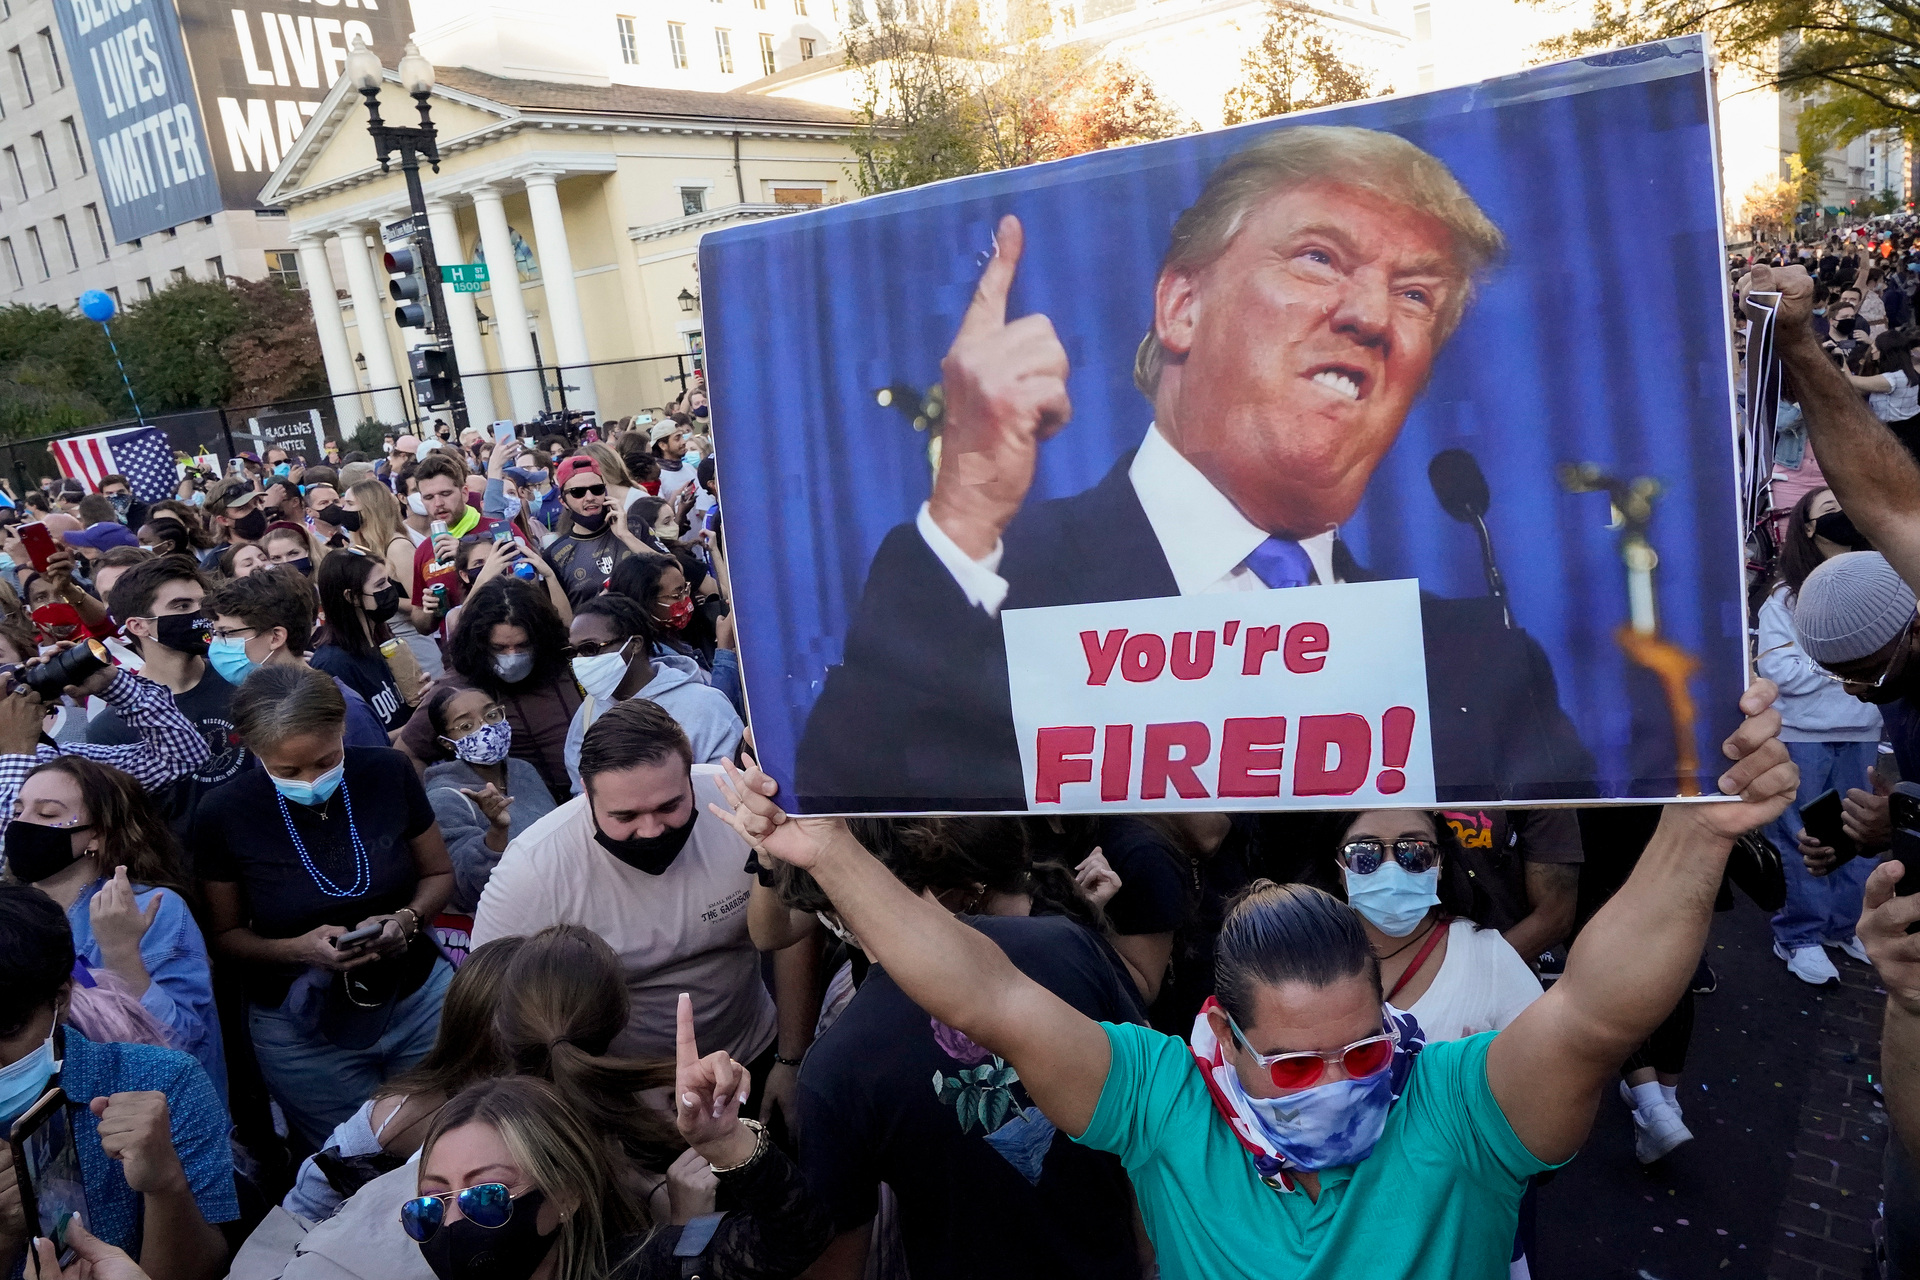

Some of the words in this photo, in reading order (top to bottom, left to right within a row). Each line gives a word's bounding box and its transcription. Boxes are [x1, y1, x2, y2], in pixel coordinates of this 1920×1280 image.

[89, 18, 166, 119] LIVES
[98, 103, 206, 207] MATTER
[451, 267, 464, 281] H
[454, 282, 481, 291] 1500
[288, 421, 312, 436] LIVES
[371, 680, 400, 725] got
[202, 718, 235, 730] WISCONSIN
[1035, 705, 1416, 804] FIRED!
[701, 909, 718, 922] THE
[719, 890, 751, 914] GARRISON
